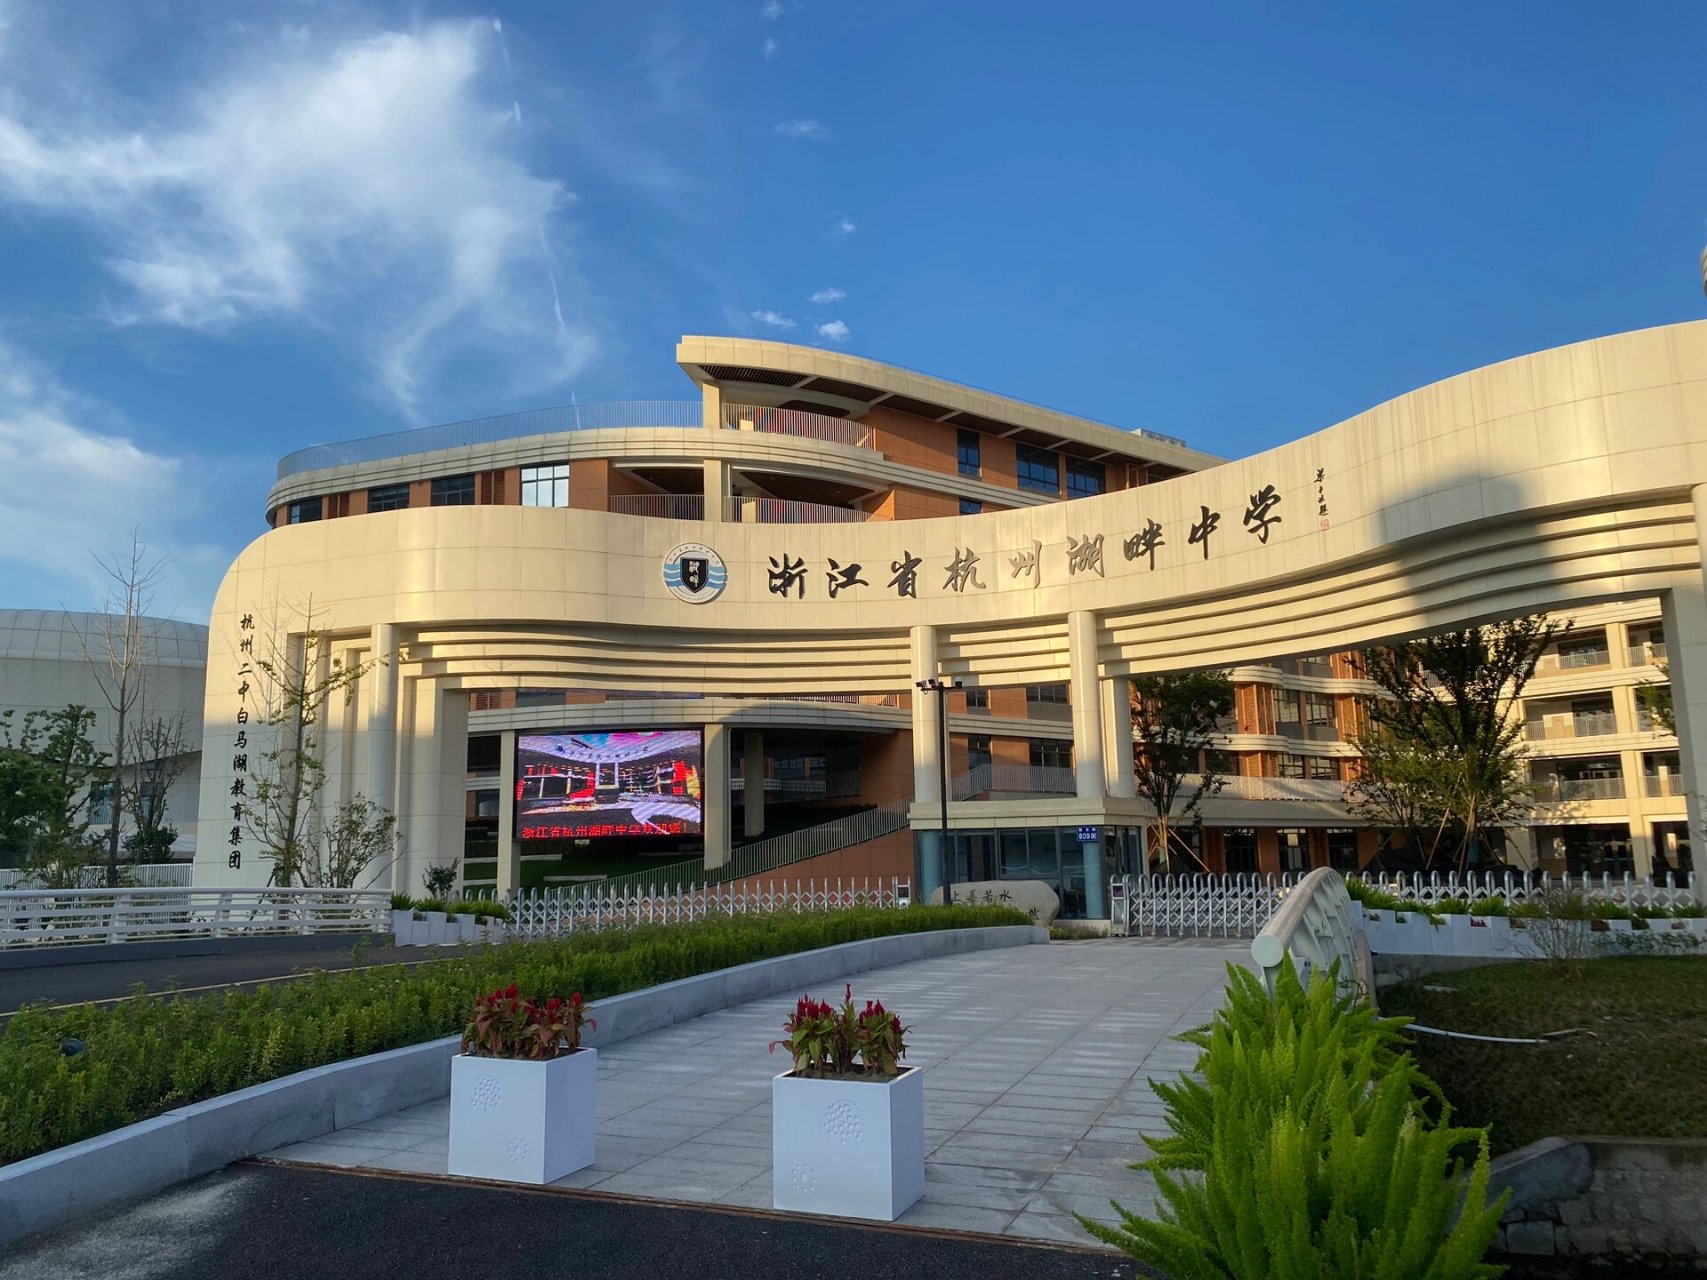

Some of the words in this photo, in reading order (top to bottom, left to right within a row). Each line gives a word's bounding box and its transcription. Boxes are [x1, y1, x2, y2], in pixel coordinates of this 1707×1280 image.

[767, 485, 1282, 600] 浙江省杭州湖畔中学
[228, 613, 256, 870] 杭州二中白马湖教育集团
